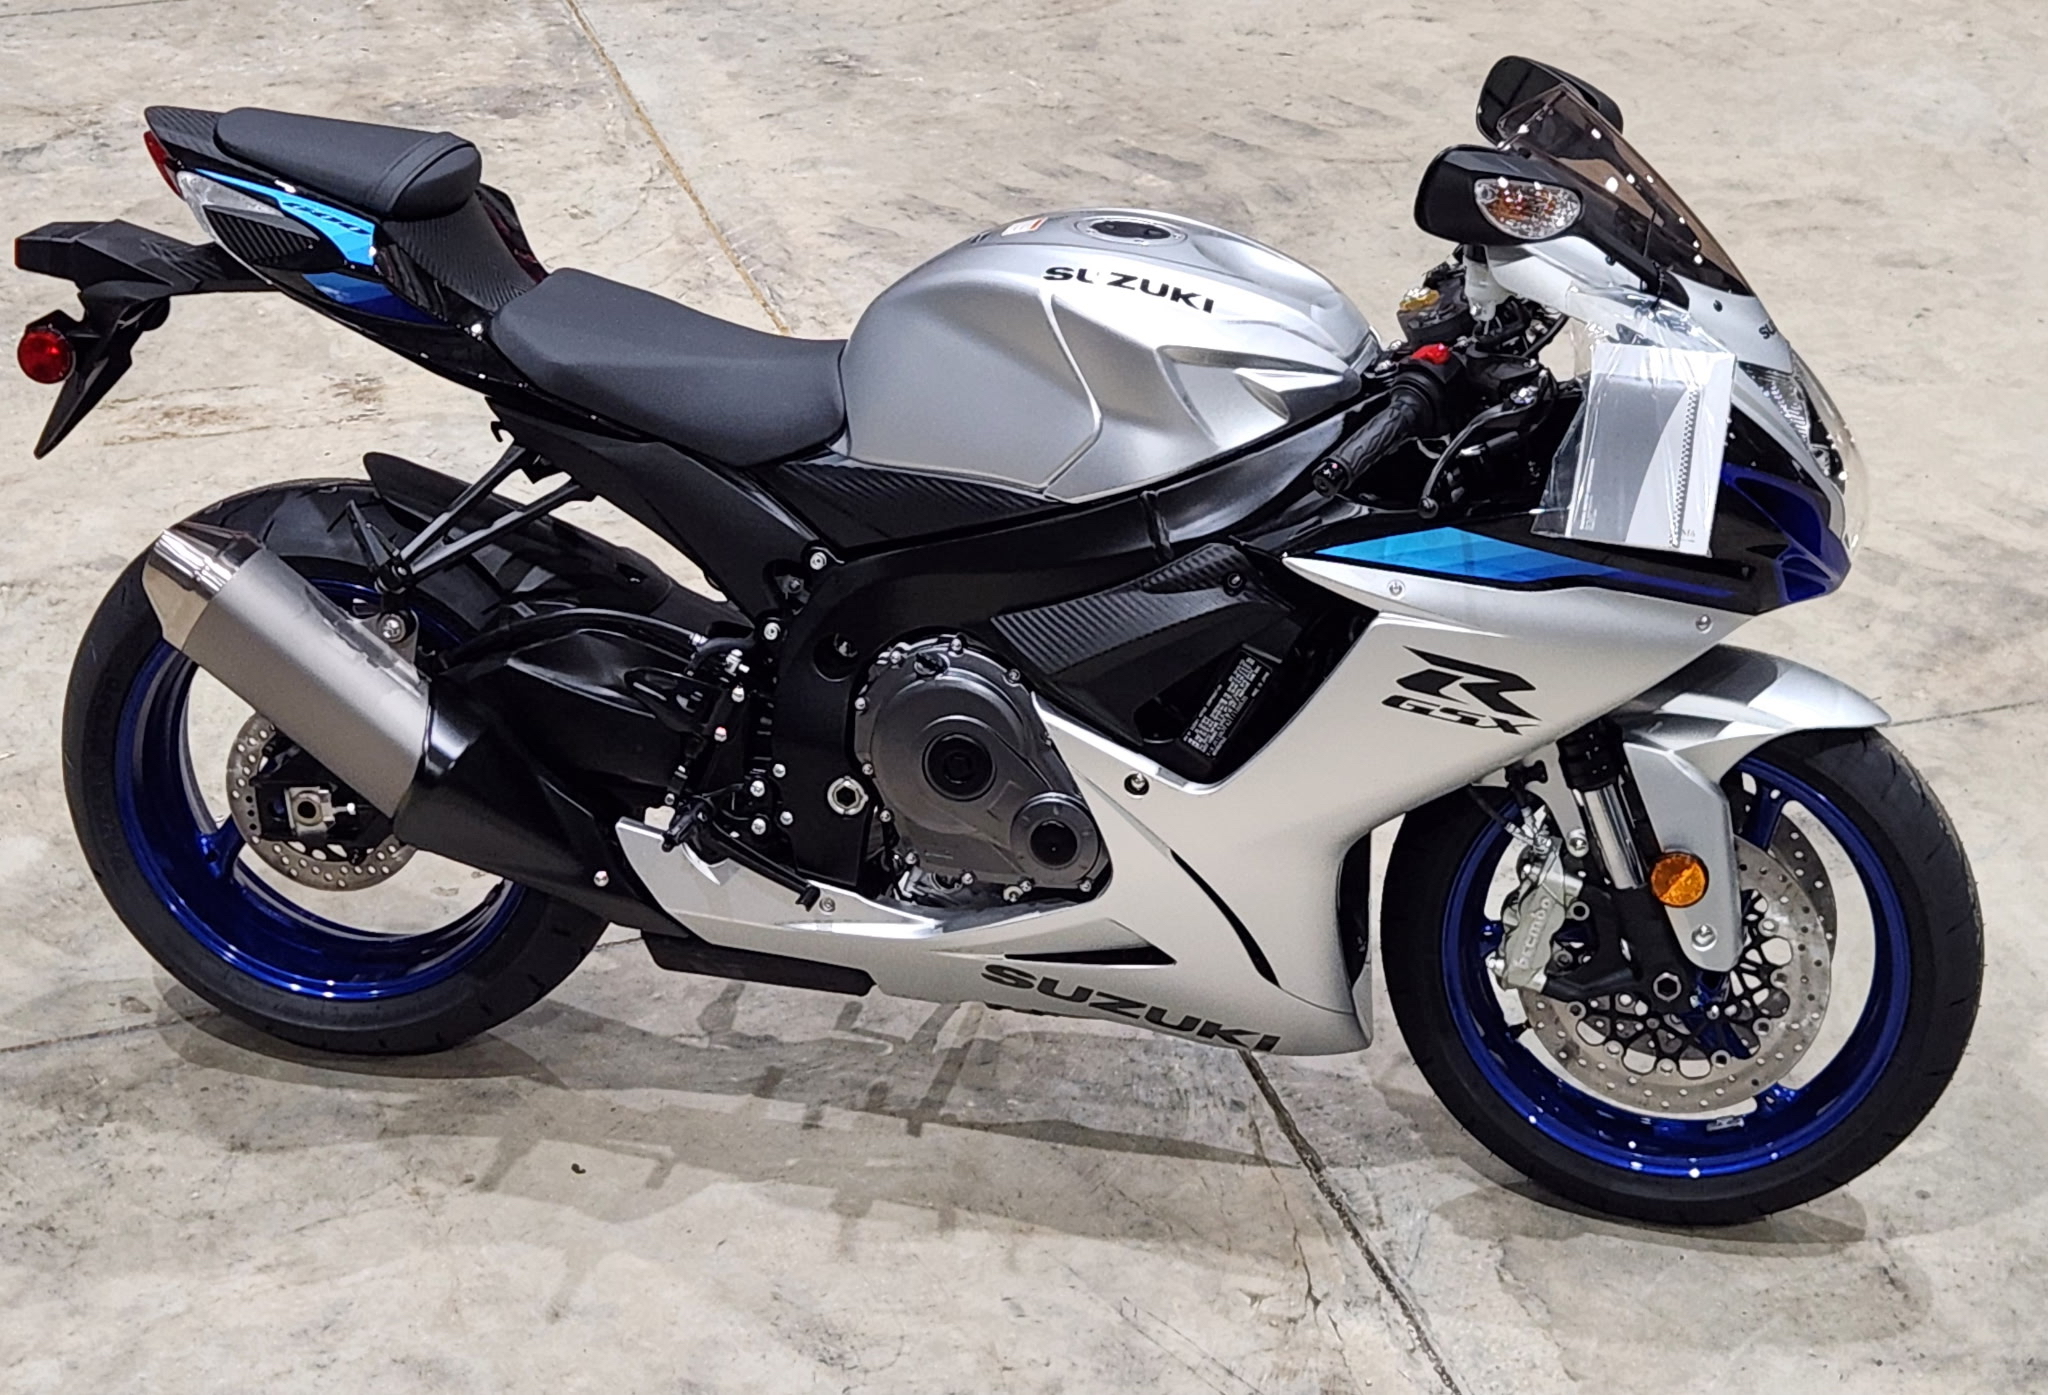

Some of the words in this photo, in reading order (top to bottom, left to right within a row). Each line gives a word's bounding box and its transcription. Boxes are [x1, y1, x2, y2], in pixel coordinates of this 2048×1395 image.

[1381, 694, 1540, 736] GSX
[1396, 645, 1542, 721] R
[1513, 896, 1552, 970] brembo
[981, 954, 1281, 1052] SUZUKI
